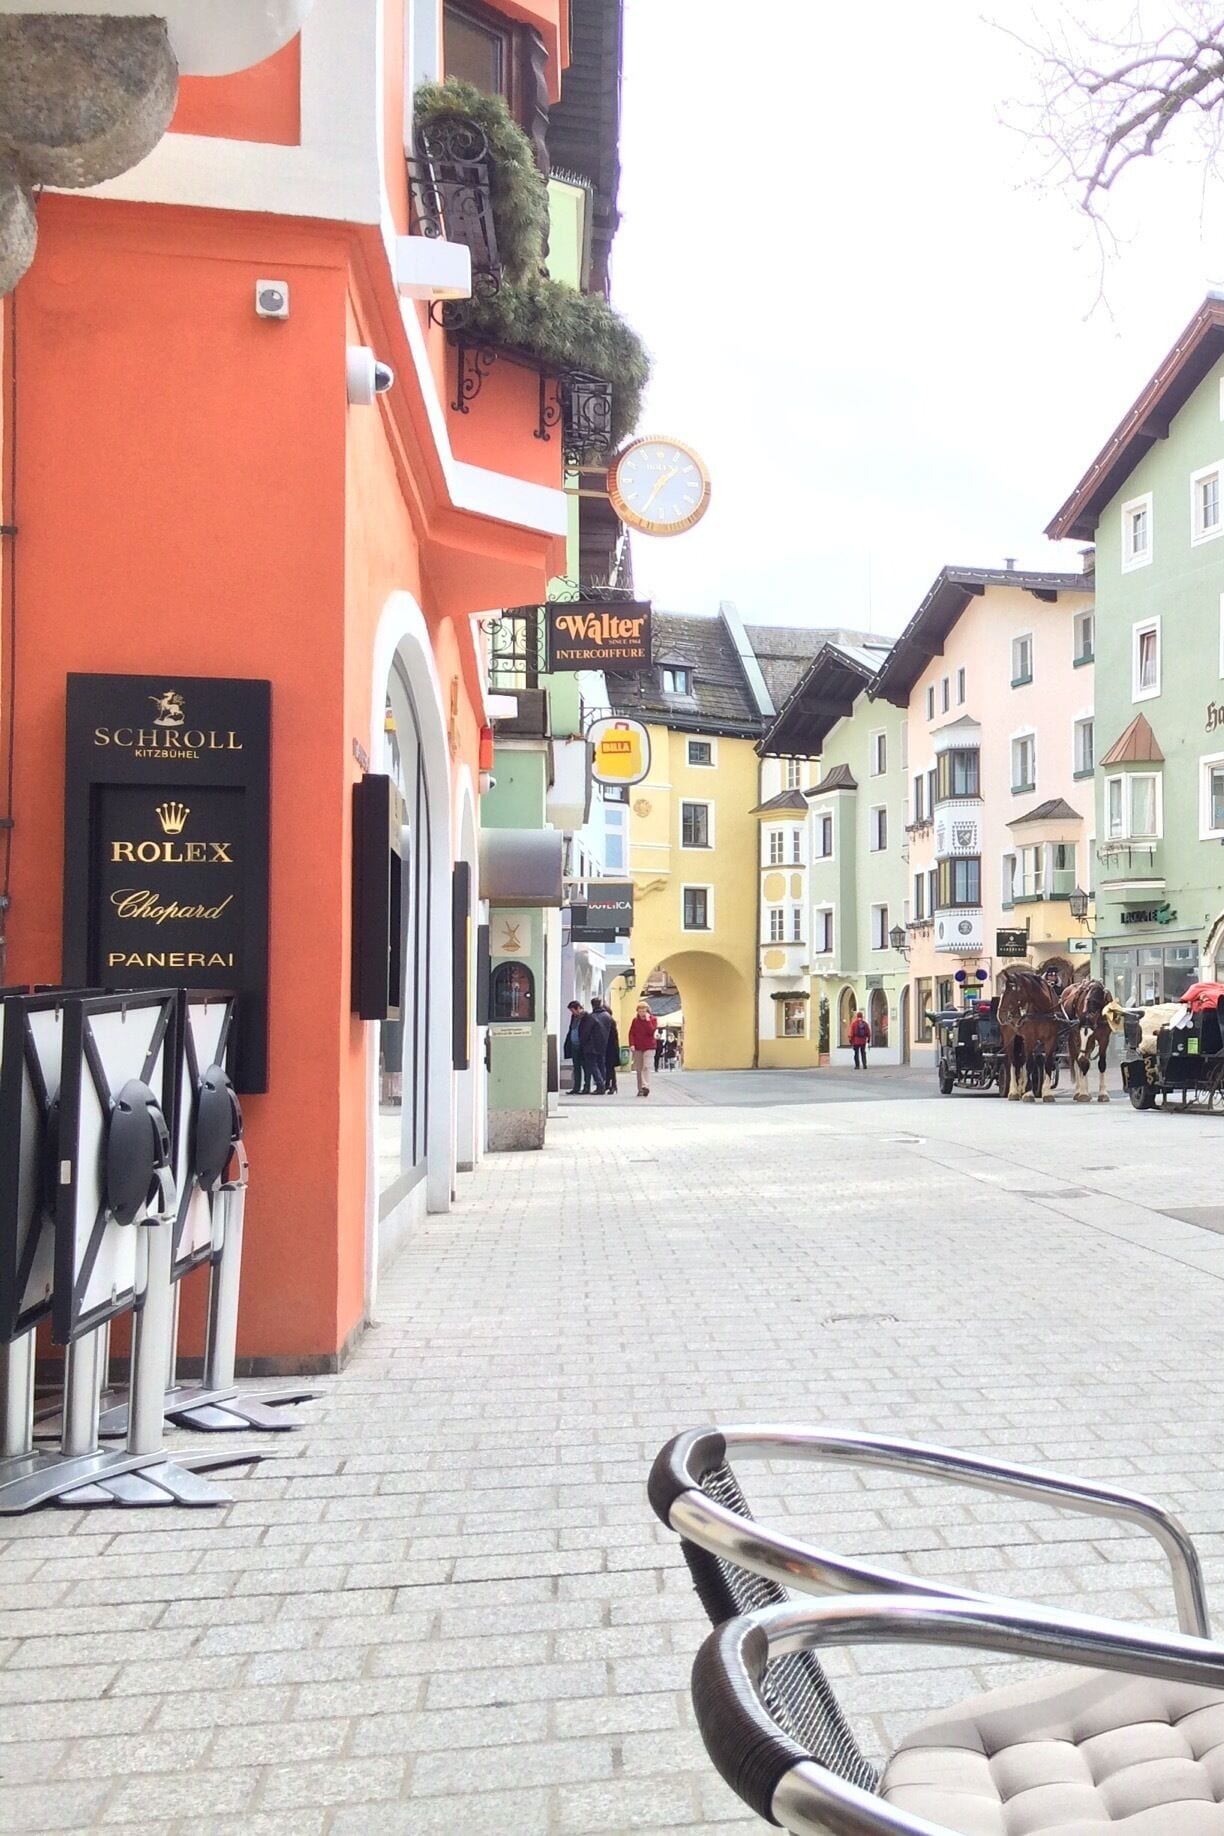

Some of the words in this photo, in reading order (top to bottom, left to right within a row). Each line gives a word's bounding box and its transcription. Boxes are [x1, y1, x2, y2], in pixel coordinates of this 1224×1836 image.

[555, 612, 645, 646] Walter
[556, 648, 645, 660] INTERCOIFFURE
[94, 727, 243, 749] SCHROLL
[135, 750, 200, 760] KITZBÜHEL
[602, 742, 630, 752] BILLA
[111, 841, 234, 862] ROLEX
[110, 888, 234, 925] Chopard
[109, 953, 233, 967] PANERAI
